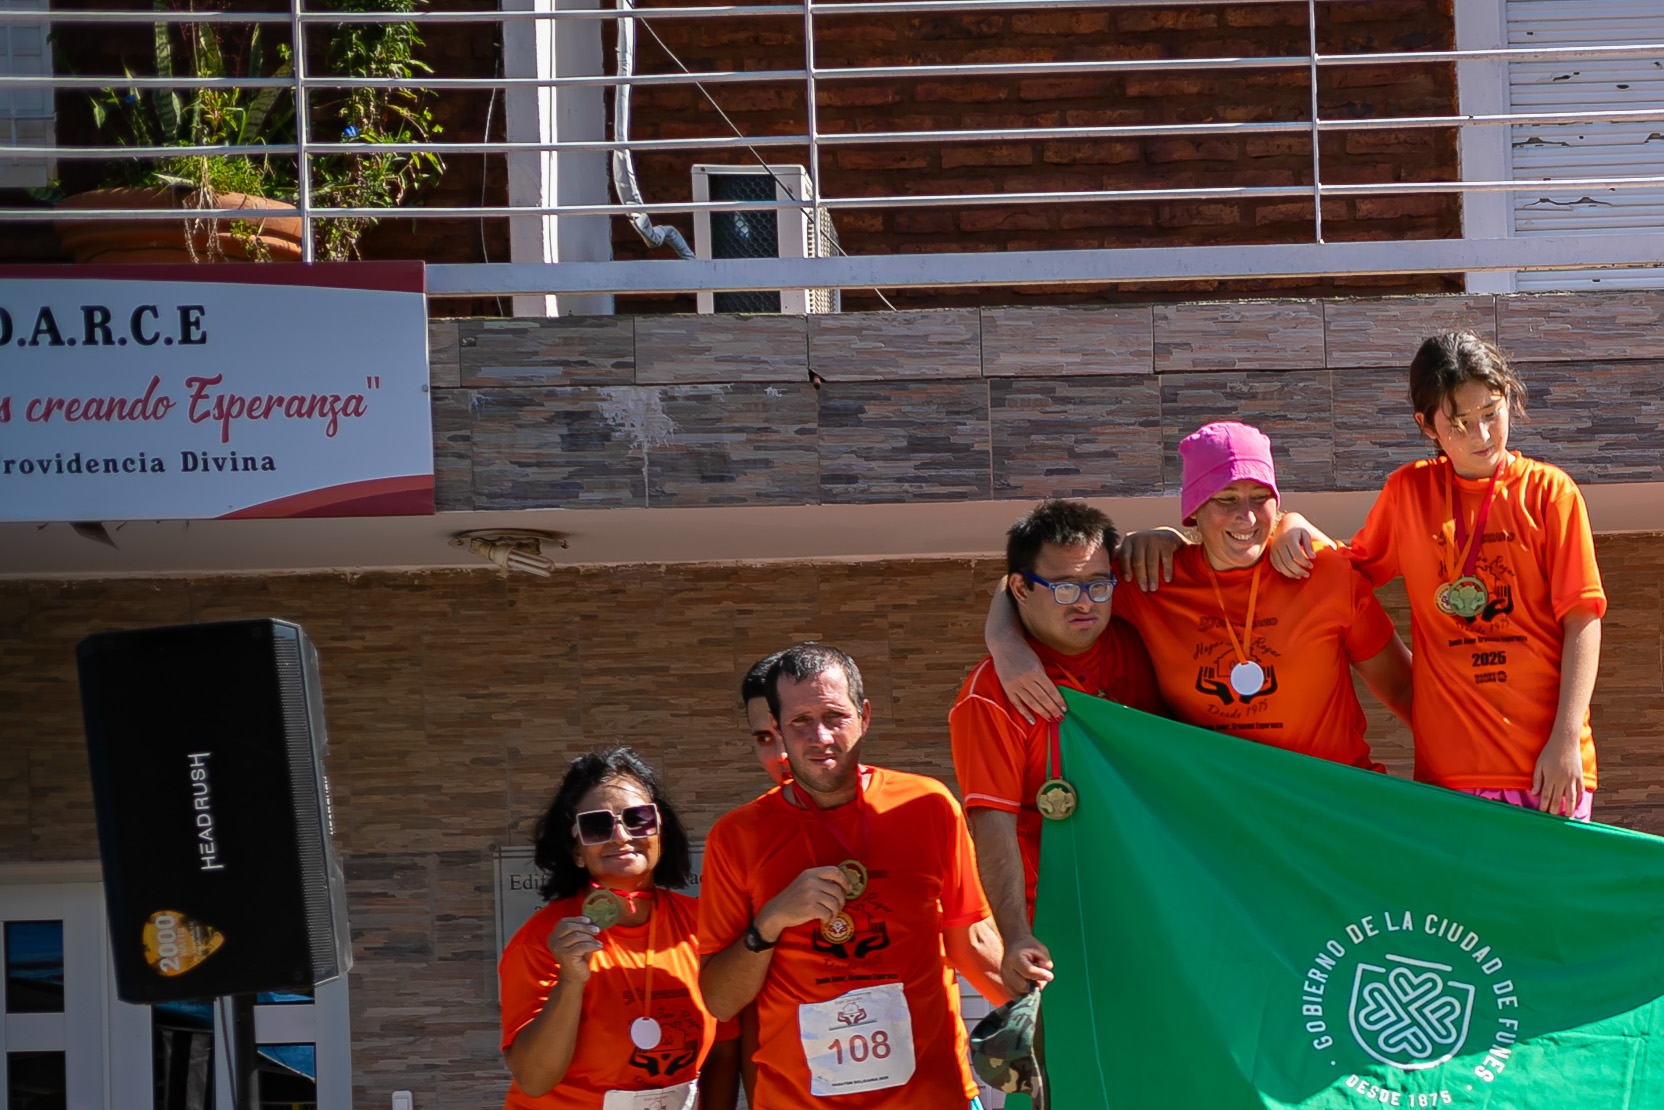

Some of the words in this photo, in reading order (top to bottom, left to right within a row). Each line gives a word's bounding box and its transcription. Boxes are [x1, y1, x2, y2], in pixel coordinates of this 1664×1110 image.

[25, 375, 176, 424] creando
[0, 452, 165, 474] rovidencia
[181, 450, 276, 472] Divina
[1472, 651, 1507, 667] 2025
[187, 752, 225, 871] HEADRUSH
[1345, 915, 1380, 945] DE
[1384, 911, 1414, 931] LA
[155, 914, 181, 973] 2000
[1424, 913, 1503, 976] CIUDAD
[1302, 939, 1346, 1050] GOBIERNO
[1492, 979, 1519, 1010] DE
[828, 1029, 892, 1066] 108
[1473, 1017, 1519, 1083] FUNES
[1345, 1073, 1401, 1107] DESDE
[1408, 1089, 1452, 1109] 1875
